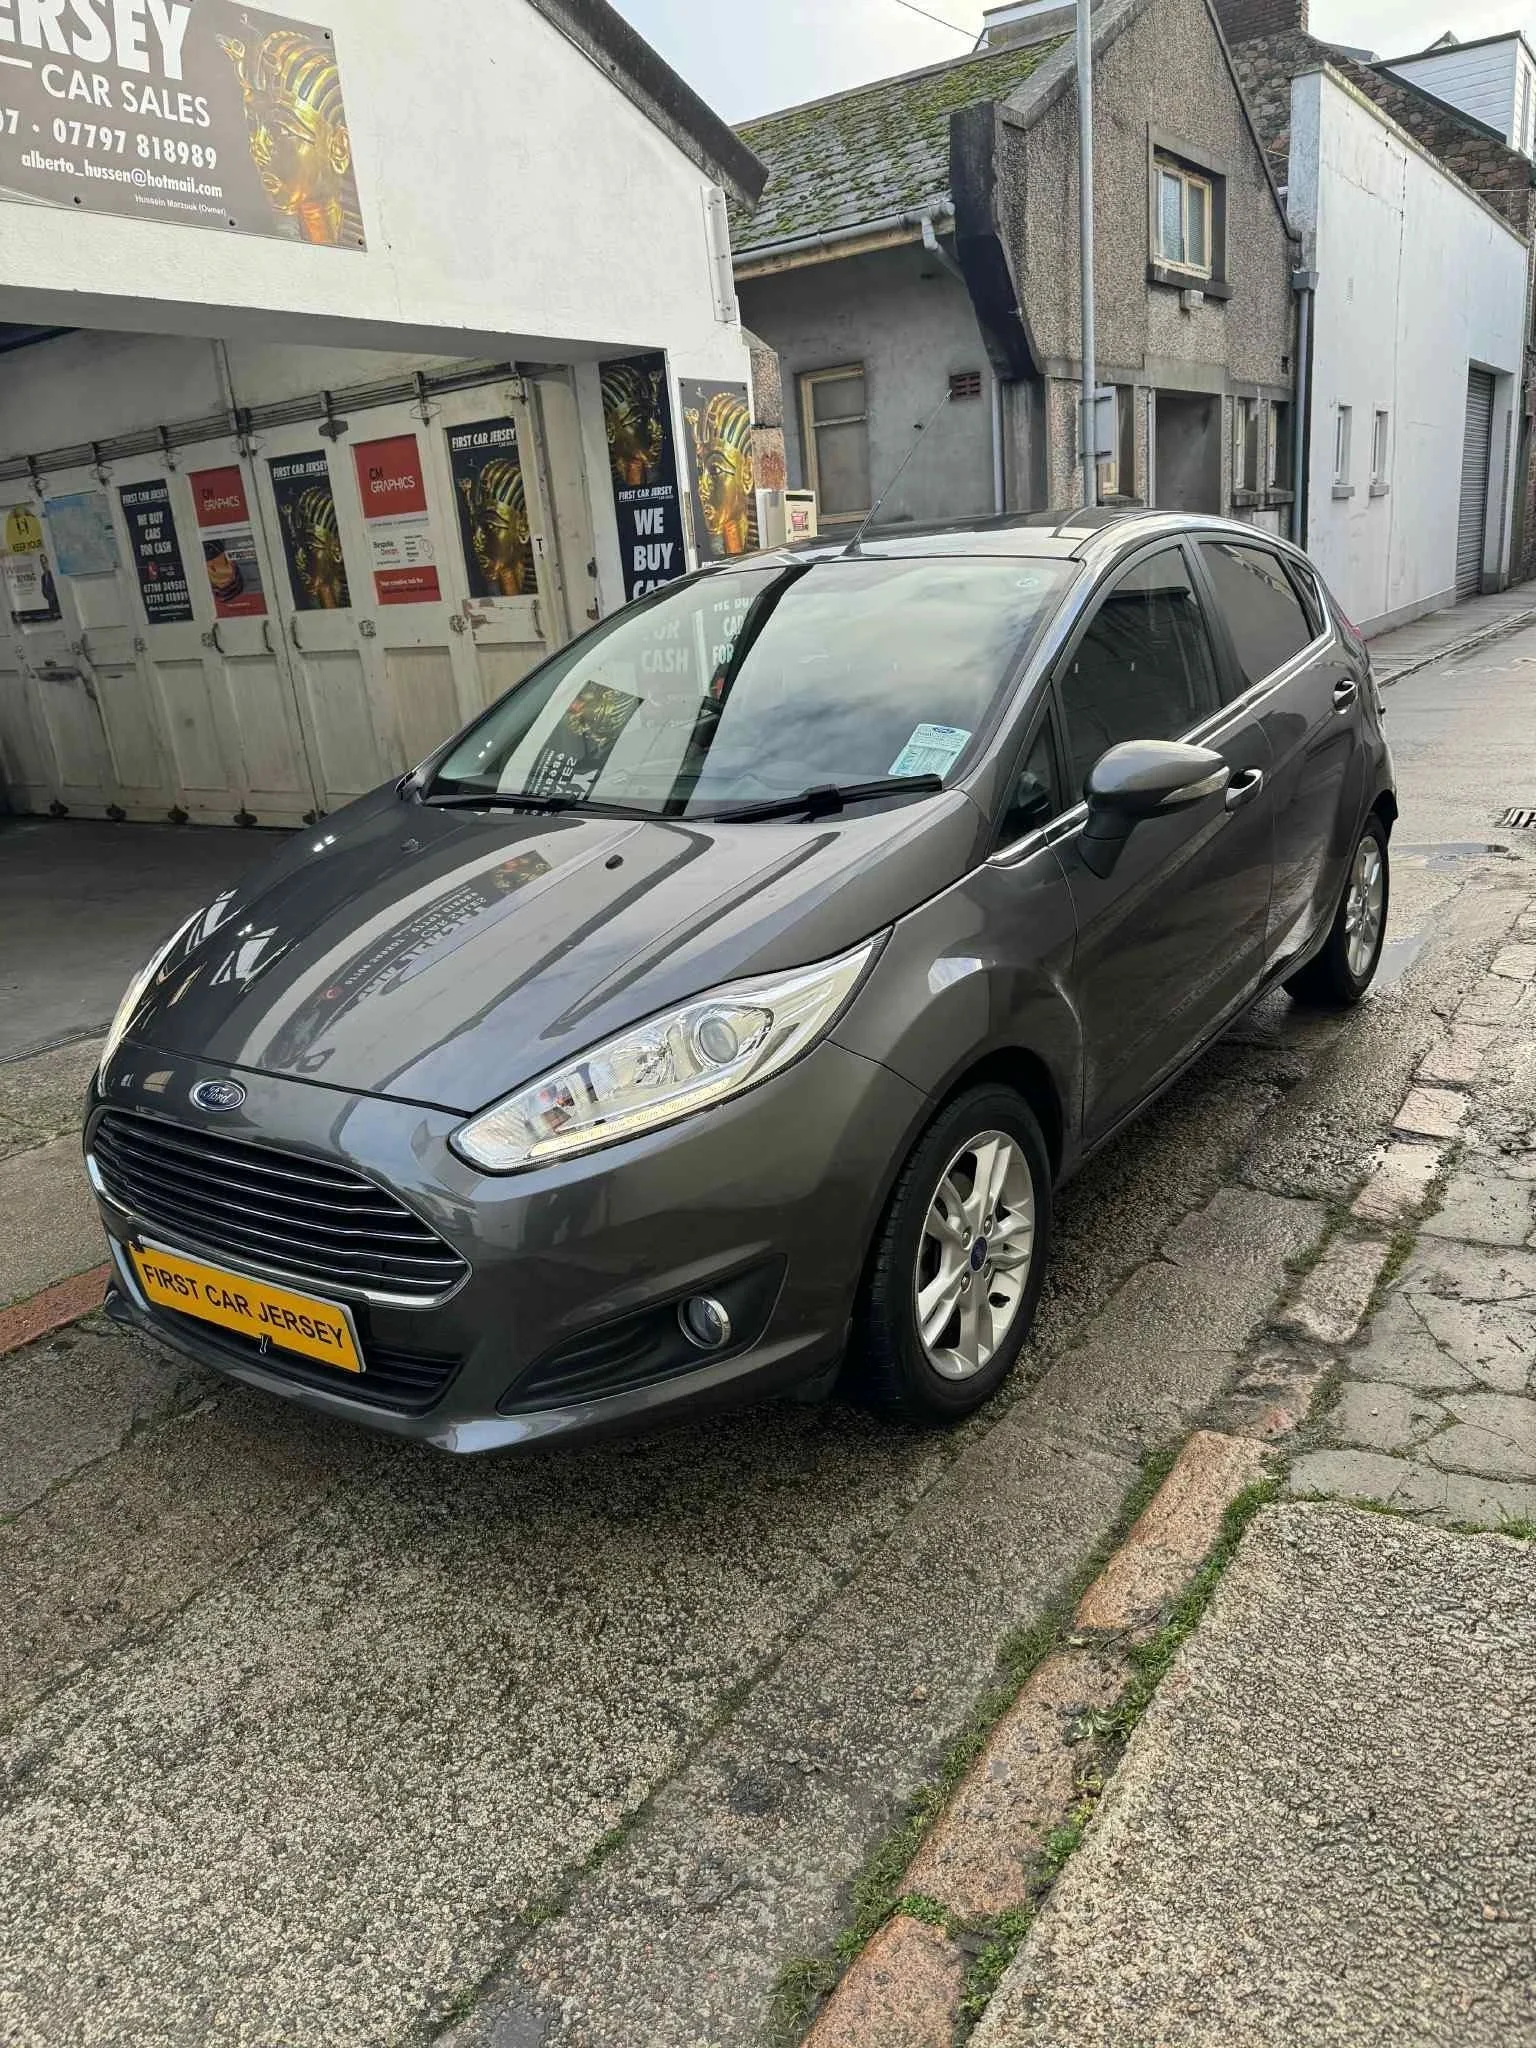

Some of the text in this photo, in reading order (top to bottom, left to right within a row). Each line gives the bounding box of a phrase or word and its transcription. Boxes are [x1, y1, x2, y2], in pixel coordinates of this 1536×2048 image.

[0, 0, 191, 80] RSEY
[41, 64, 211, 127] CAR SALES
[53, 118, 127, 153] 07797
[136, 134, 217, 169] 818989
[21, 150, 223, 198] alberto_hussen@hotmail.com
[452, 435, 472, 449] FIRST
[473, 432, 488, 445] CAR
[490, 428, 515, 442] JERSEY
[273, 466, 290, 478] FIRST
[291, 463, 305, 475] CAR
[370, 475, 416, 493] GRAPHICS
[618, 490, 636, 501] FIRST
[637, 488, 650, 499] CAR
[651, 485, 673, 497] JERSEY
[633, 507, 664, 536] WE
[633, 542, 674, 572] BUY
[641, 646, 689, 673] CASH
[712, 643, 734, 666] FOR
[141, 1262, 344, 1350] FIRST CAR JERSEY
